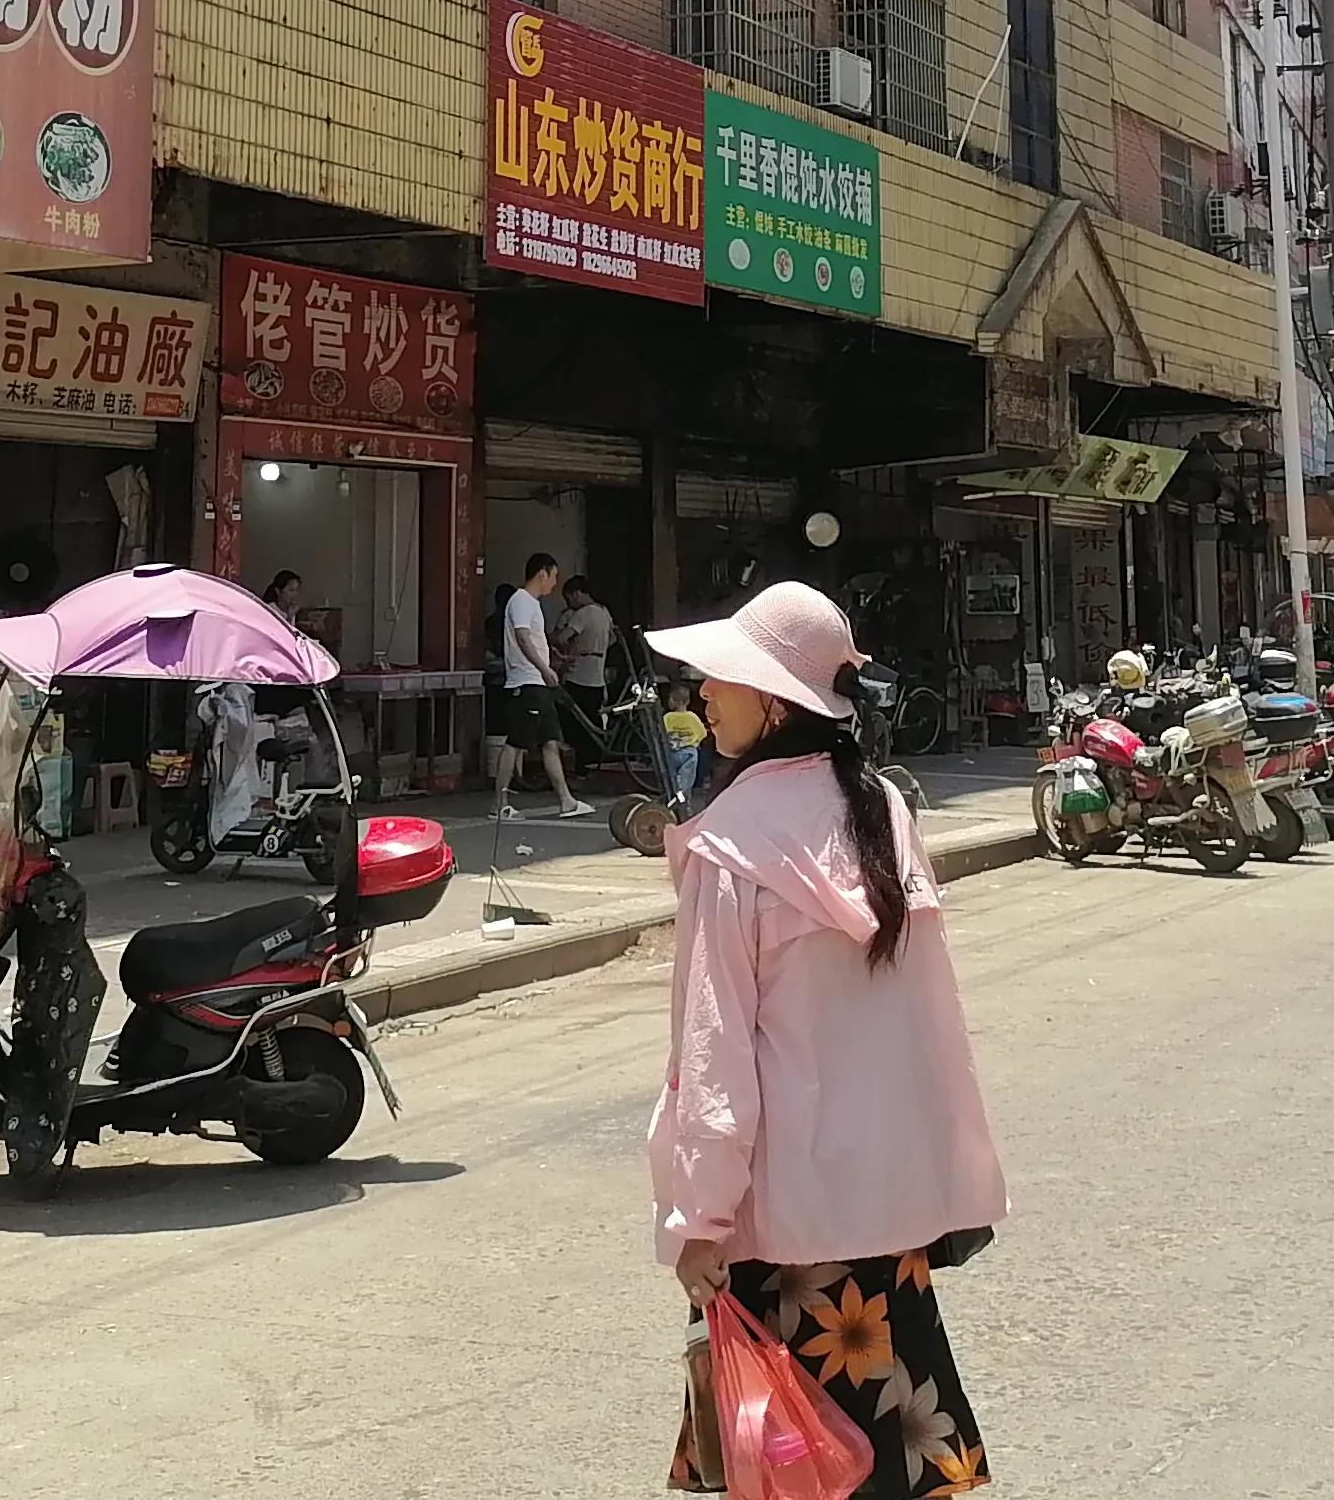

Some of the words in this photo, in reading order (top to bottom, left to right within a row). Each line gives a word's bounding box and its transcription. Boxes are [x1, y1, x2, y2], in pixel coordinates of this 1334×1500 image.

[494, 78, 704, 231] 山东炒货商行
[716, 125, 873, 227] 千里香馄饨水饺铺
[43, 204, 101, 239] 牛肉粉
[240, 268, 462, 385] 佬管炒货
